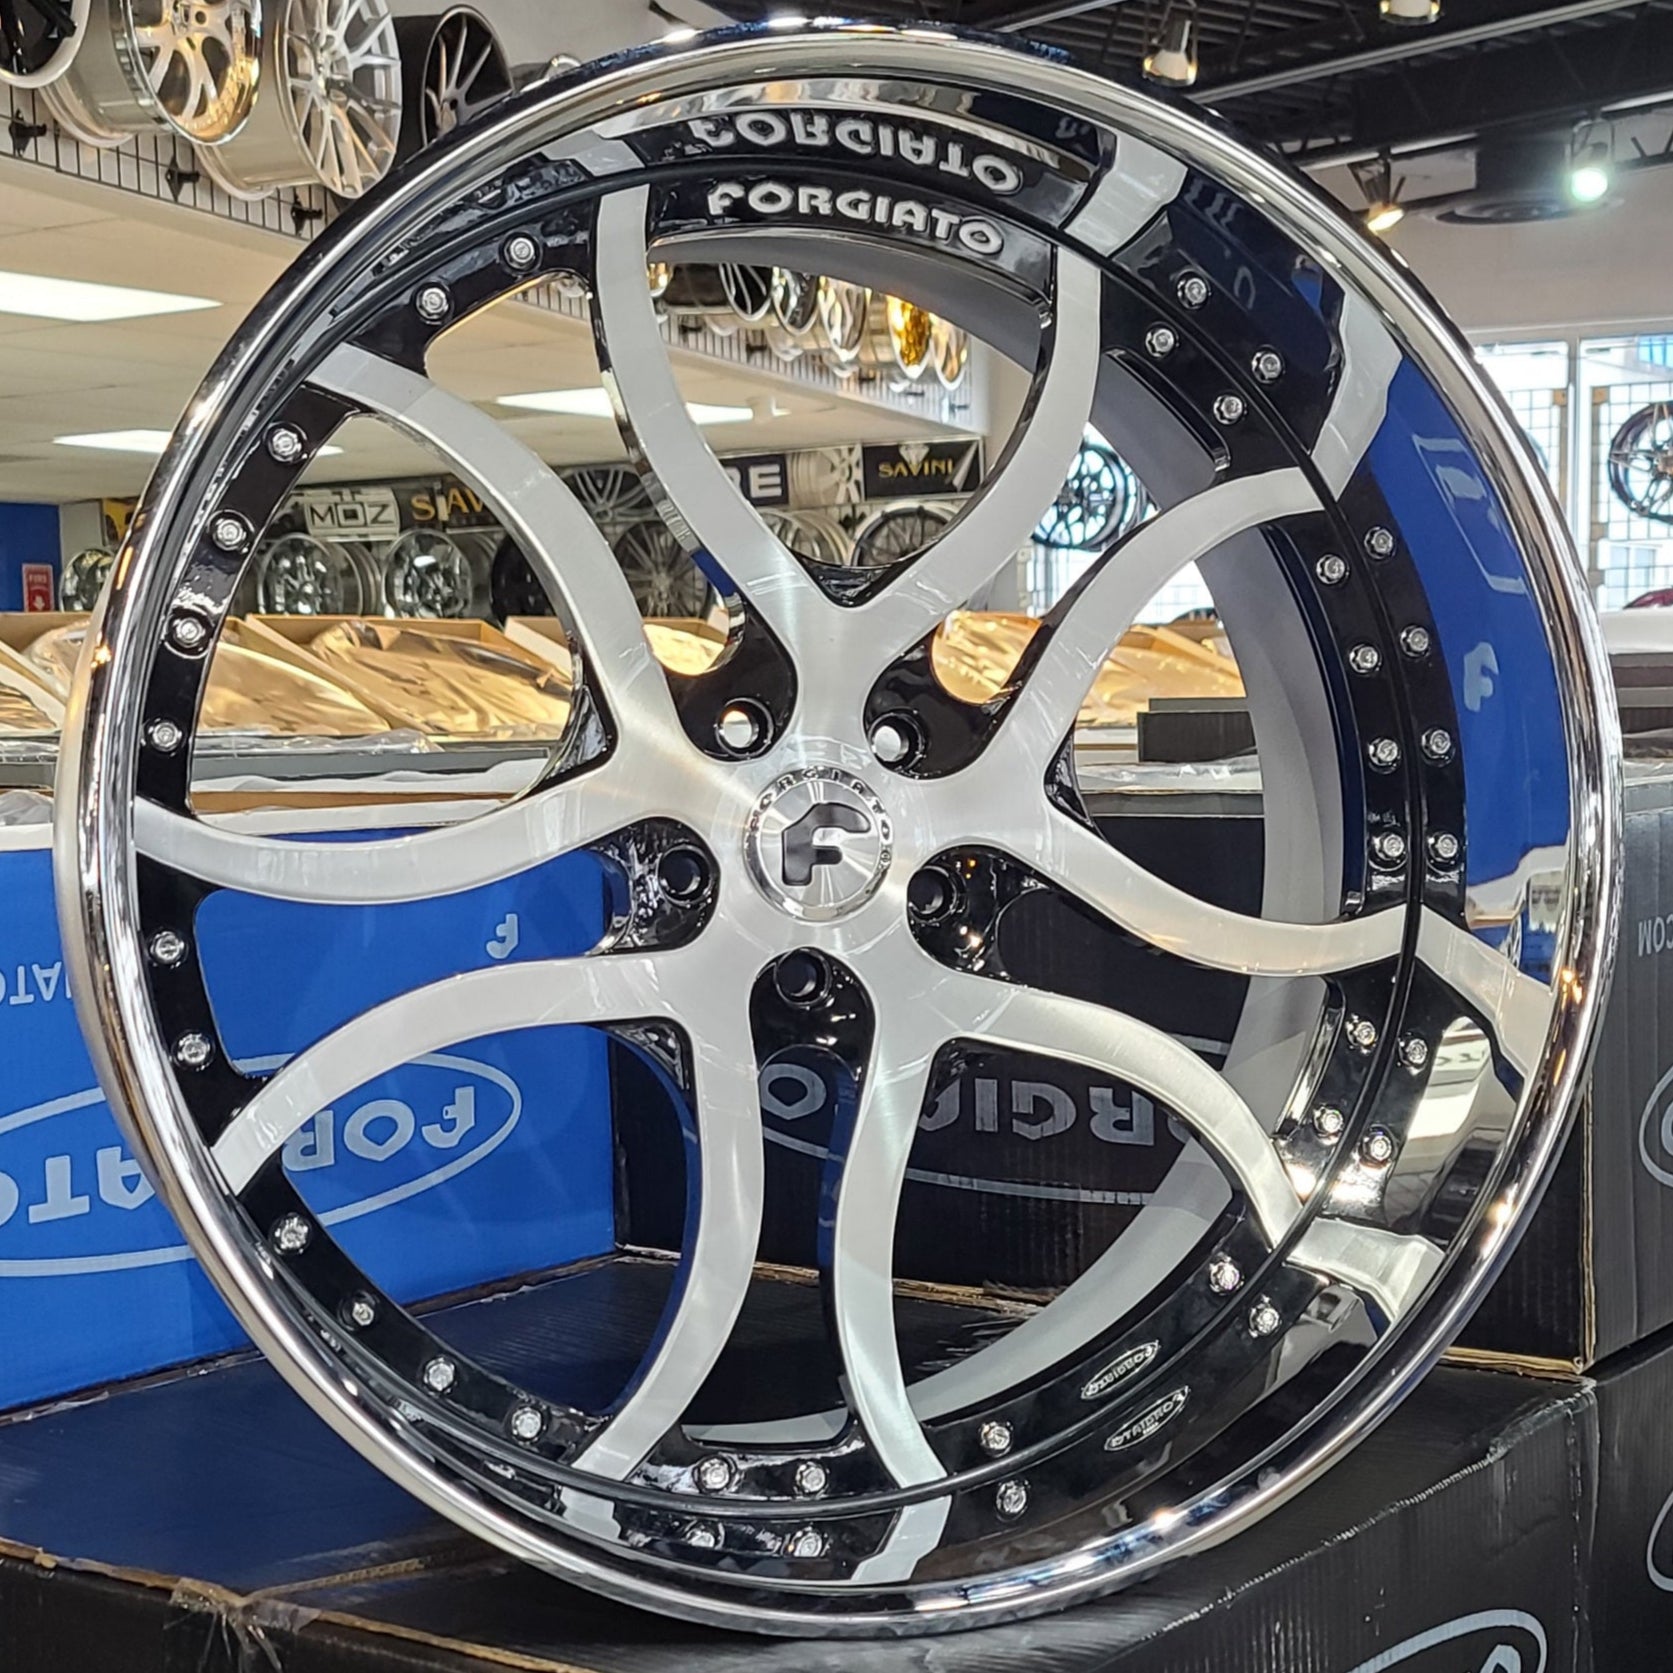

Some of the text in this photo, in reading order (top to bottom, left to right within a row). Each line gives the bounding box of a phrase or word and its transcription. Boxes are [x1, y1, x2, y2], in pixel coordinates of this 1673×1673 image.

[706, 181, 1005, 255] FORGIATO
[878, 458, 954, 479] SAVINI
[411, 487, 484, 521] SAV
[782, 802, 871, 887] F
[486, 913, 519, 959] F
